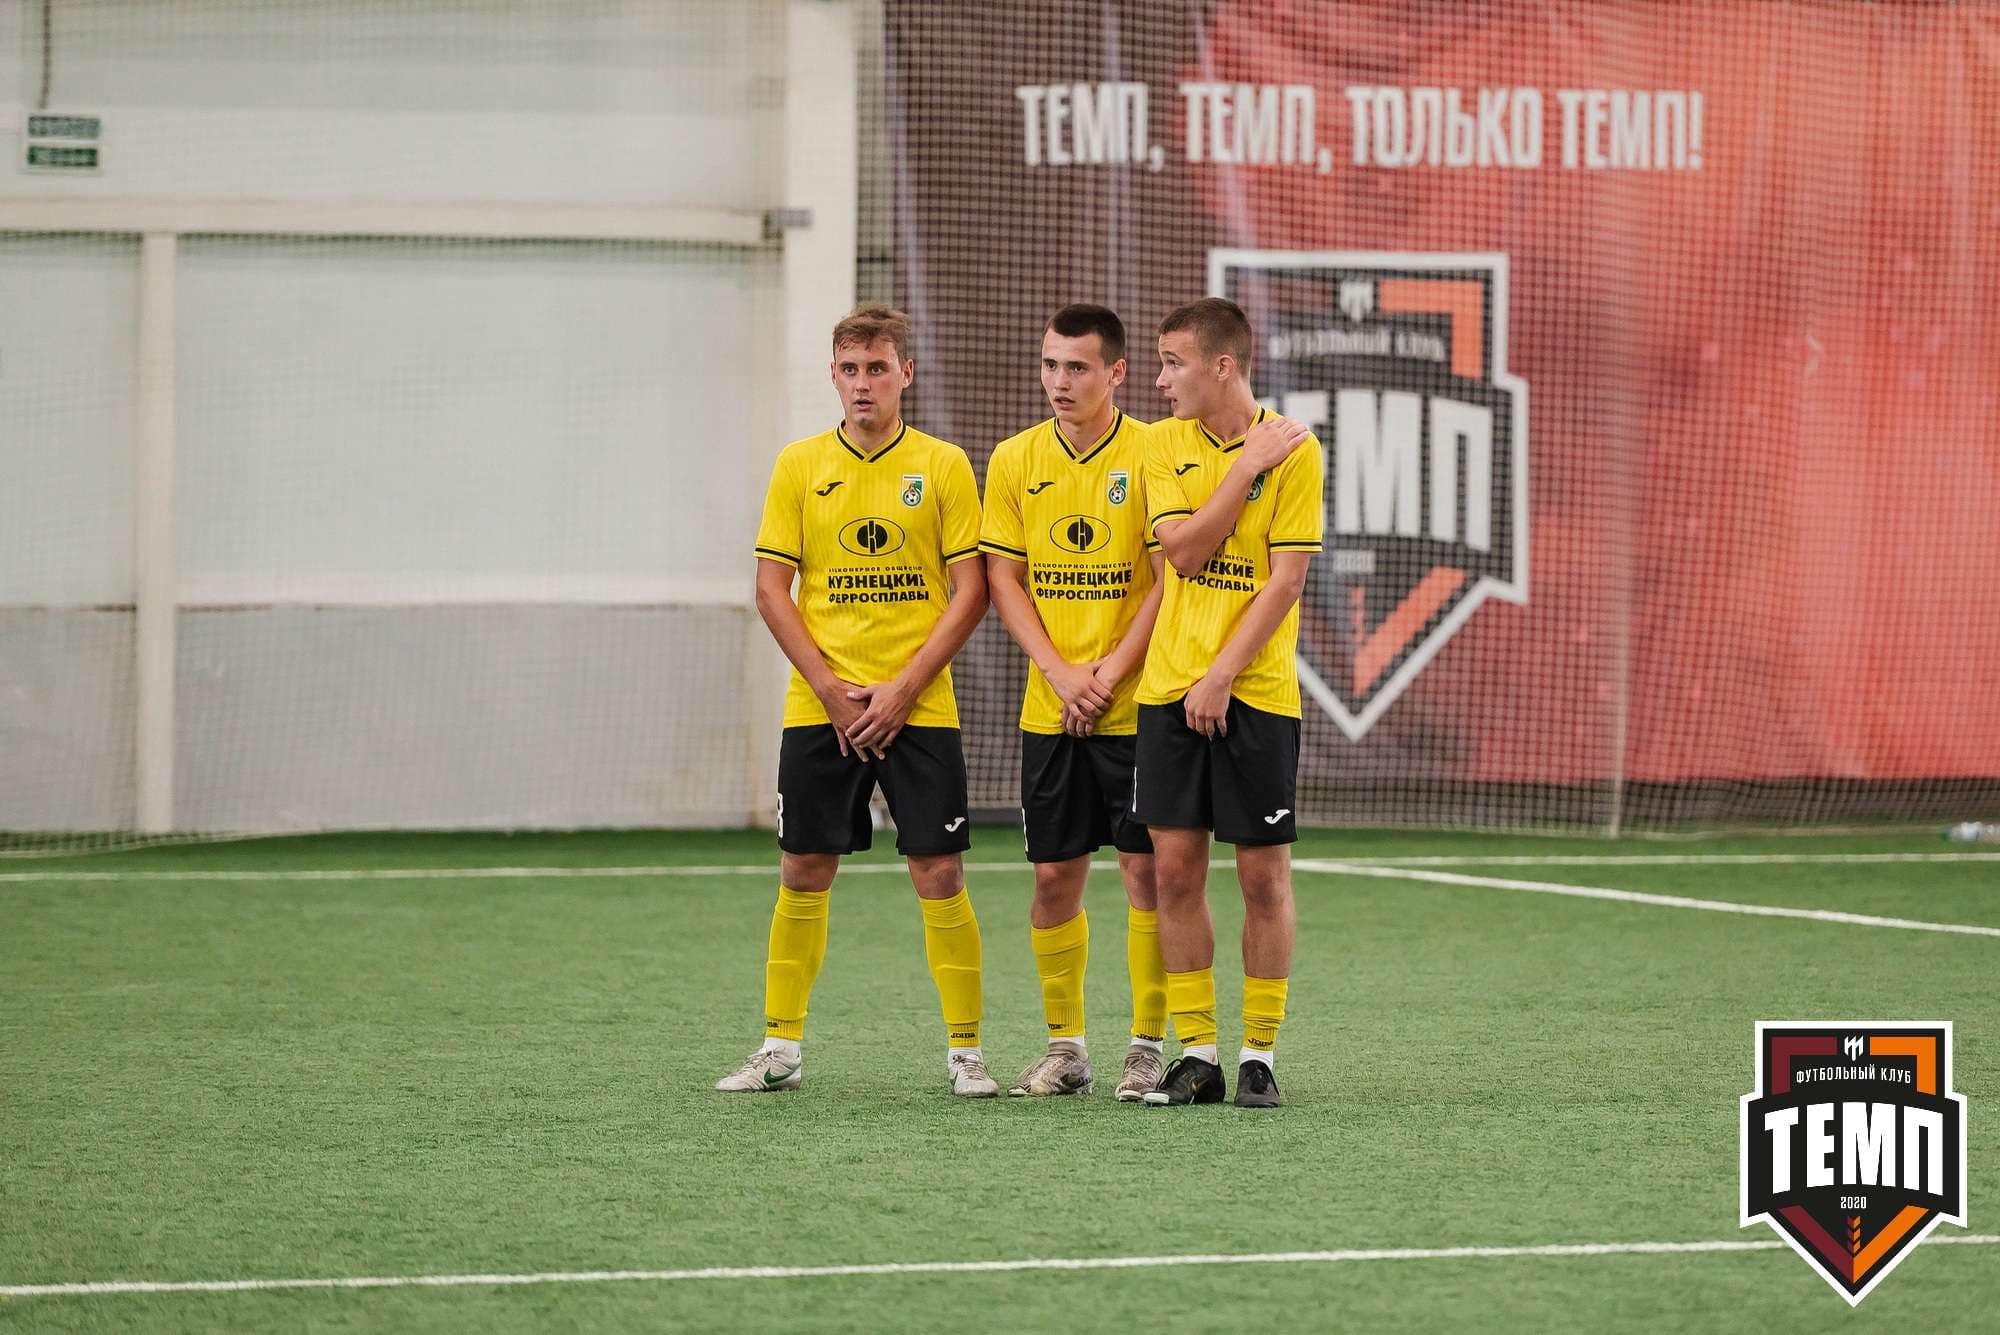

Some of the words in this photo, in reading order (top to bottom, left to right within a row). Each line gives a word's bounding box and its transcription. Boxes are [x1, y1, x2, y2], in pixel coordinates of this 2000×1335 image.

[1015, 82, 1165, 172] ТЕМП,
[1179, 82, 1332, 174] ТЕМП,
[1345, 85, 1544, 168] ТОЛЬКО
[1556, 89, 1704, 170] ТЕМП!
[828, 573, 926, 590] КУЗНЕЦКИЕ
[1033, 569, 1133, 588] КУЗНЕЦКИЕ
[828, 590, 930, 604] ФЕРРОСПЛАВЫ
